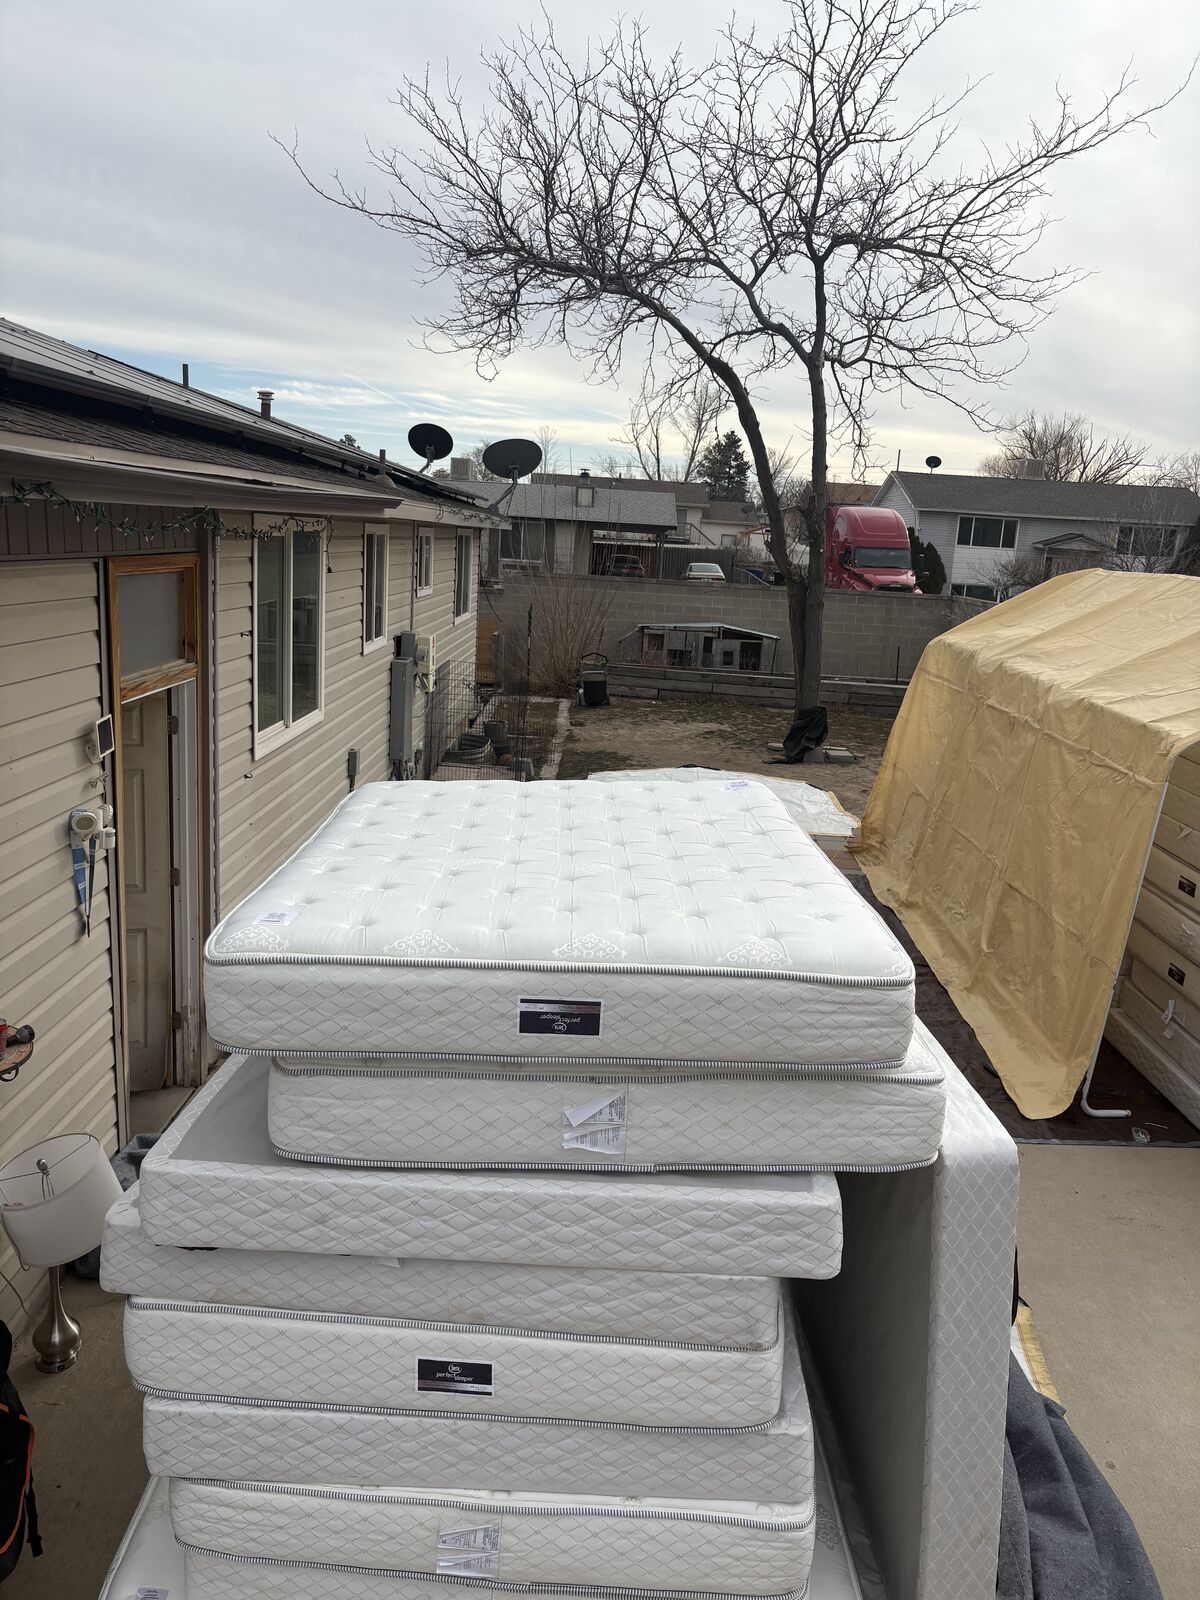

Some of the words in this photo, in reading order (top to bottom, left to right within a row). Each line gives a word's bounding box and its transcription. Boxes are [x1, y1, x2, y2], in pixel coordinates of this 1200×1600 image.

[539, 1013, 560, 1021] sleeper
[559, 1016, 581, 1024] perfect
[454, 1374, 474, 1382] sleeper
